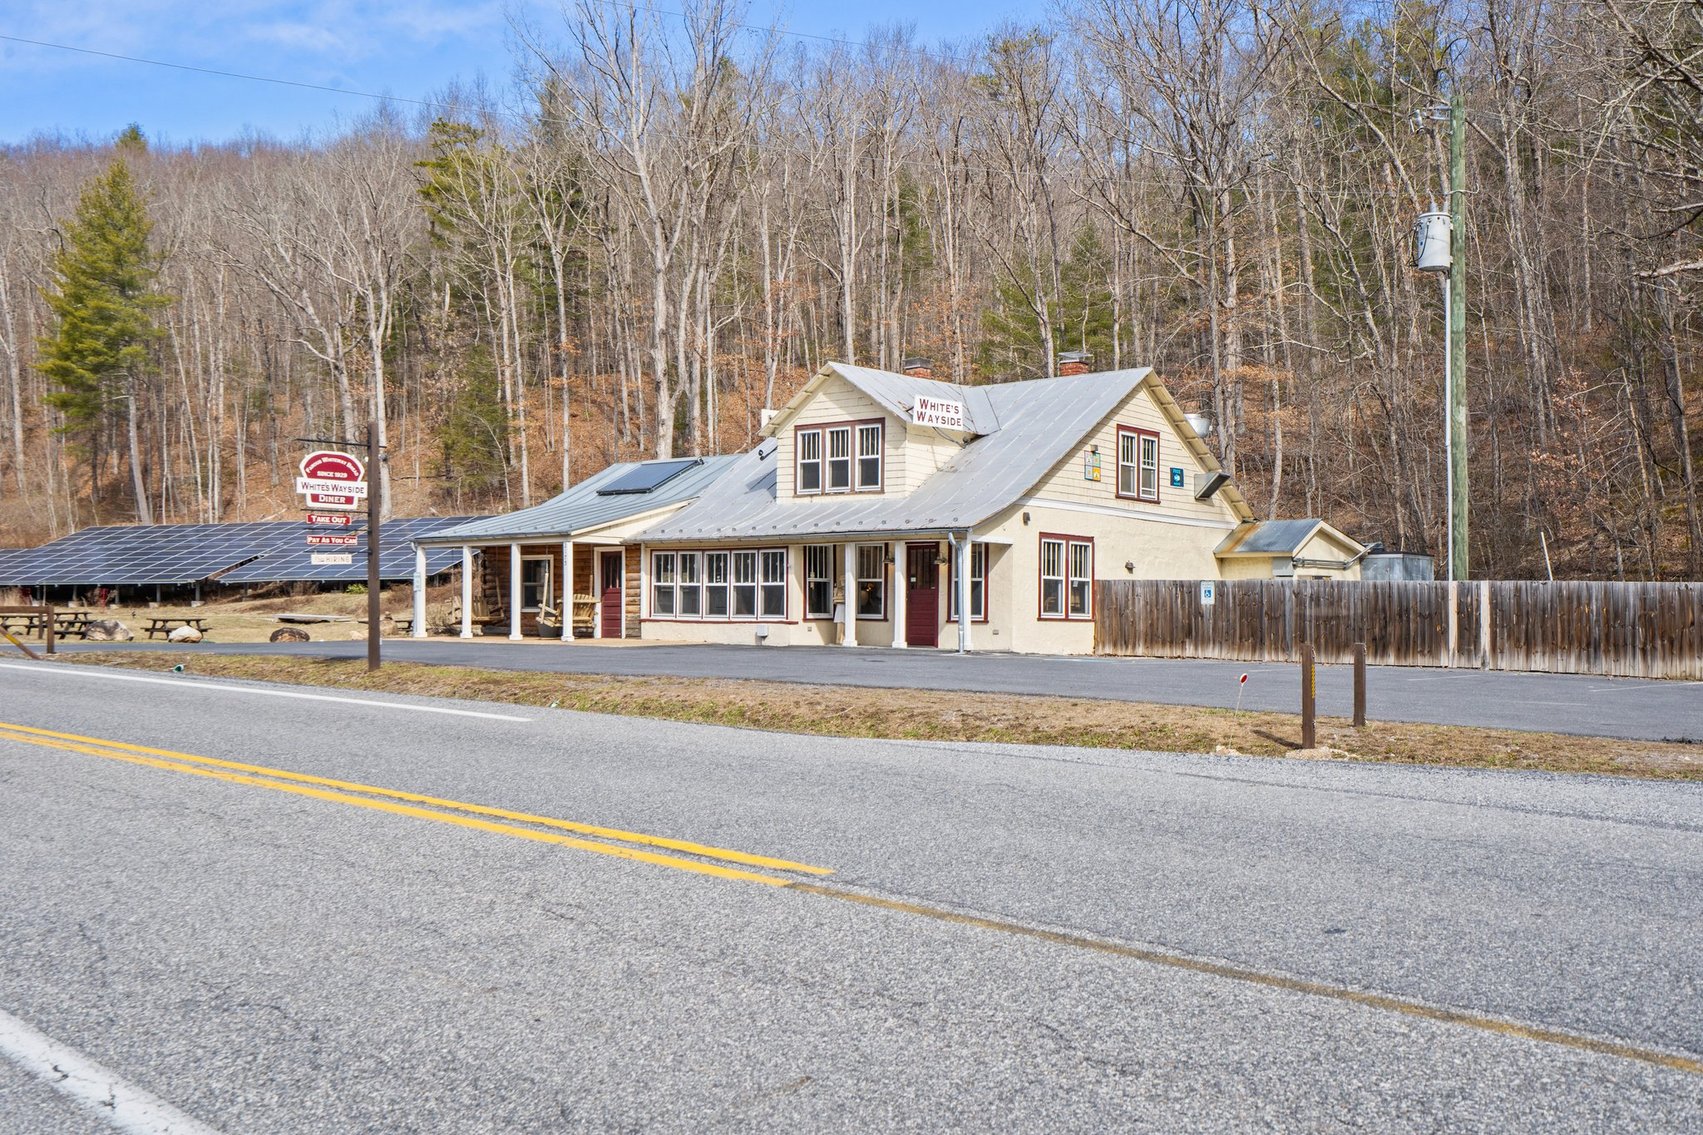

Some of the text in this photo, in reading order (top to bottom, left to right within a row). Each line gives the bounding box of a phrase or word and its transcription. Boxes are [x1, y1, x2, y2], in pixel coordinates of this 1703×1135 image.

[919, 398, 960, 414] WHITE'S
[916, 410, 962, 426] WAYSIDE
[301, 481, 365, 494] WHITE'S WAYSIDE
[319, 494, 346, 503] DINER
[311, 515, 347, 524] TAKE OUT
[307, 536, 320, 544] PAY
[344, 537, 357, 545] CAN
